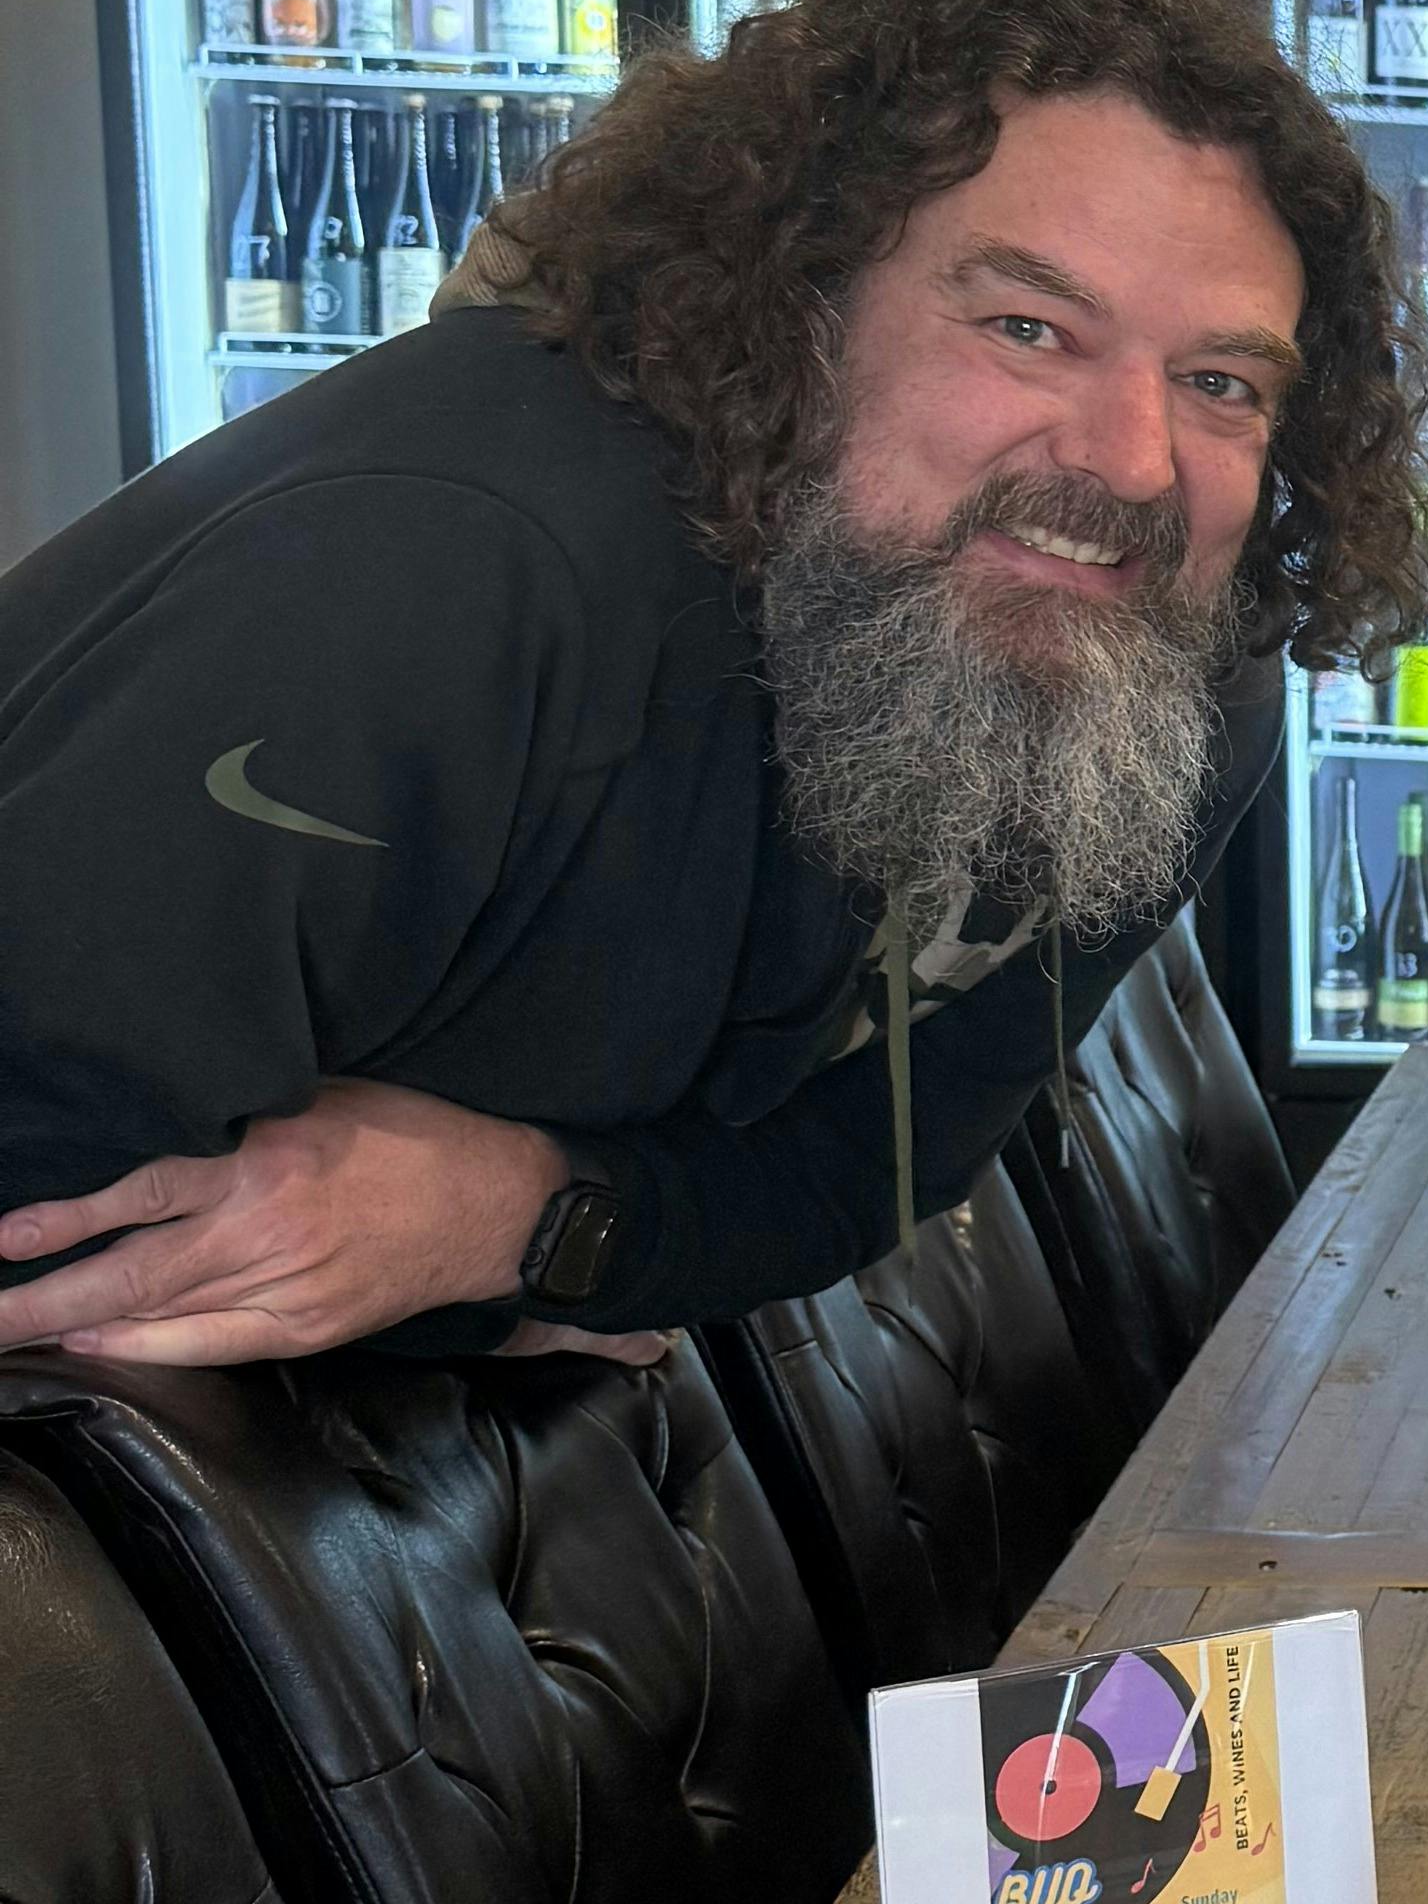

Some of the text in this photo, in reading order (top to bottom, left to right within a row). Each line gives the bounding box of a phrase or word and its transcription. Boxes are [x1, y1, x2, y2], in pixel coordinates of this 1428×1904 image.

[1226, 1645, 1249, 1851] BEATS, WINES AND LIFE
